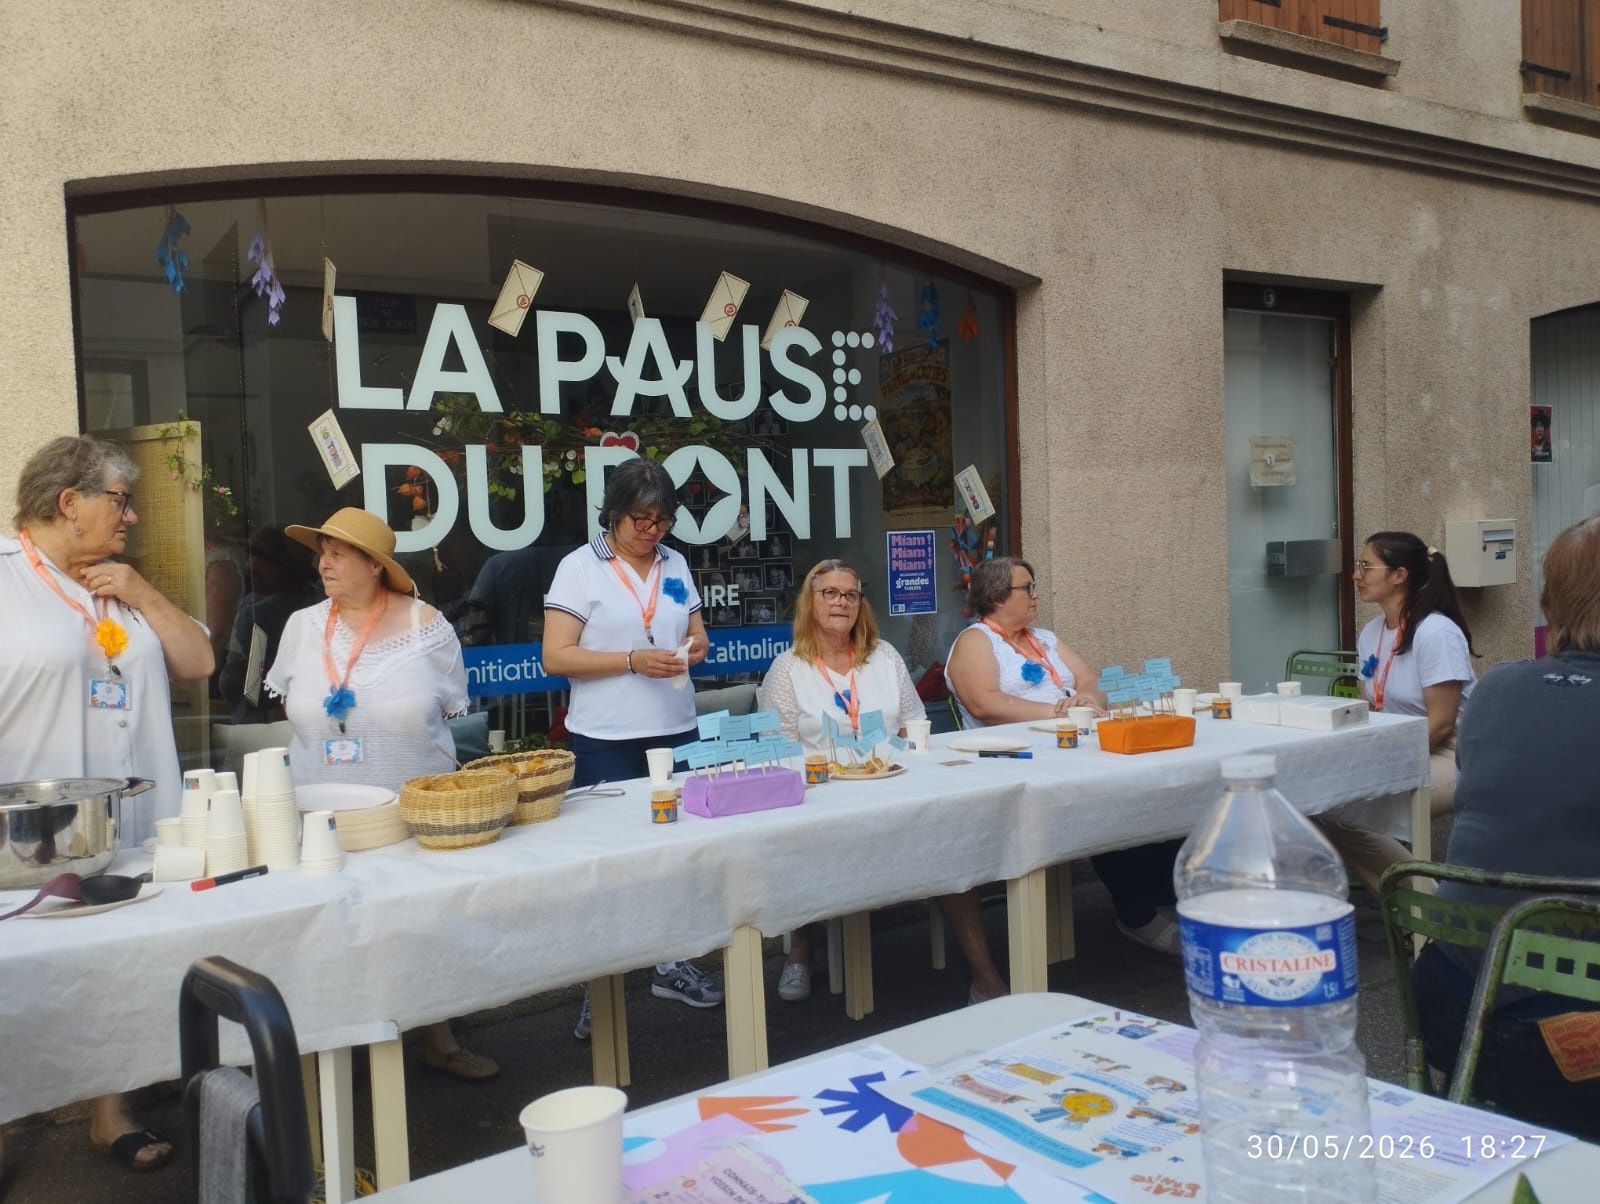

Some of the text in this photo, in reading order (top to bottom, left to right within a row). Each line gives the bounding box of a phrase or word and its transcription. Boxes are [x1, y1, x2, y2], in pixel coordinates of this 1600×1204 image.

[334, 295, 877, 422] LA PAUSE
[361, 443, 544, 553] DU
[891, 535, 925, 546] Miam
[891, 547, 925, 558] Miam
[892, 559, 926, 571] Miam
[704, 637, 790, 664] Catholiq
[1222, 952, 1334, 973] CRISTALINE
